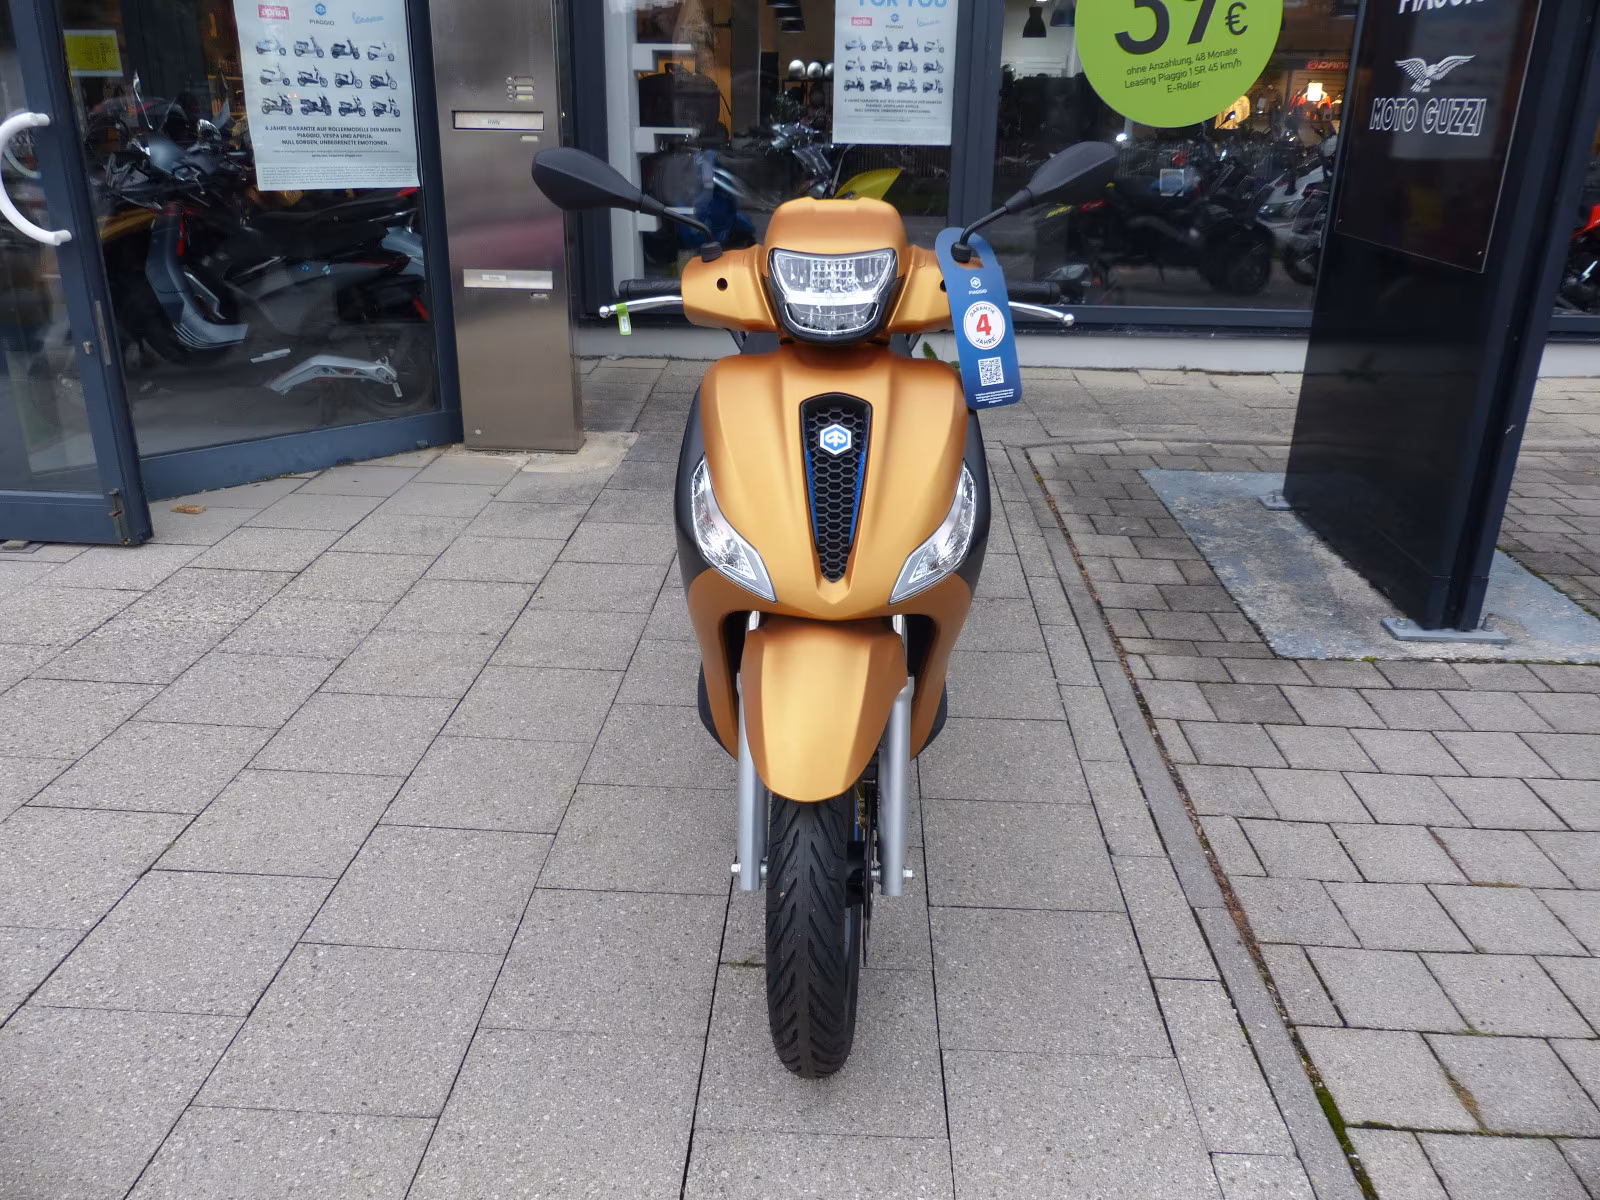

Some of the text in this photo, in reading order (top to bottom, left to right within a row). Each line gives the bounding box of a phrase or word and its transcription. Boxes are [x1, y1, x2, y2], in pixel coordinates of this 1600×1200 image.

[1124, 76, 1157, 89] Leasing
[1158, 70, 1188, 82] Piaggio
[1194, 65, 1207, 75] SR
[1208, 63, 1219, 72] 45
[1220, 58, 1242, 70] km/h
[1126, 48, 1238, 76] ohne Anzahlung, 48 Monate
[1167, 80, 1202, 93] E-Roller
[1369, 97, 1487, 136] MOTO GUZZI
[970, 305, 995, 317] GARANTIE
[976, 313, 992, 336] 4
[976, 336, 997, 346] JAHRE
